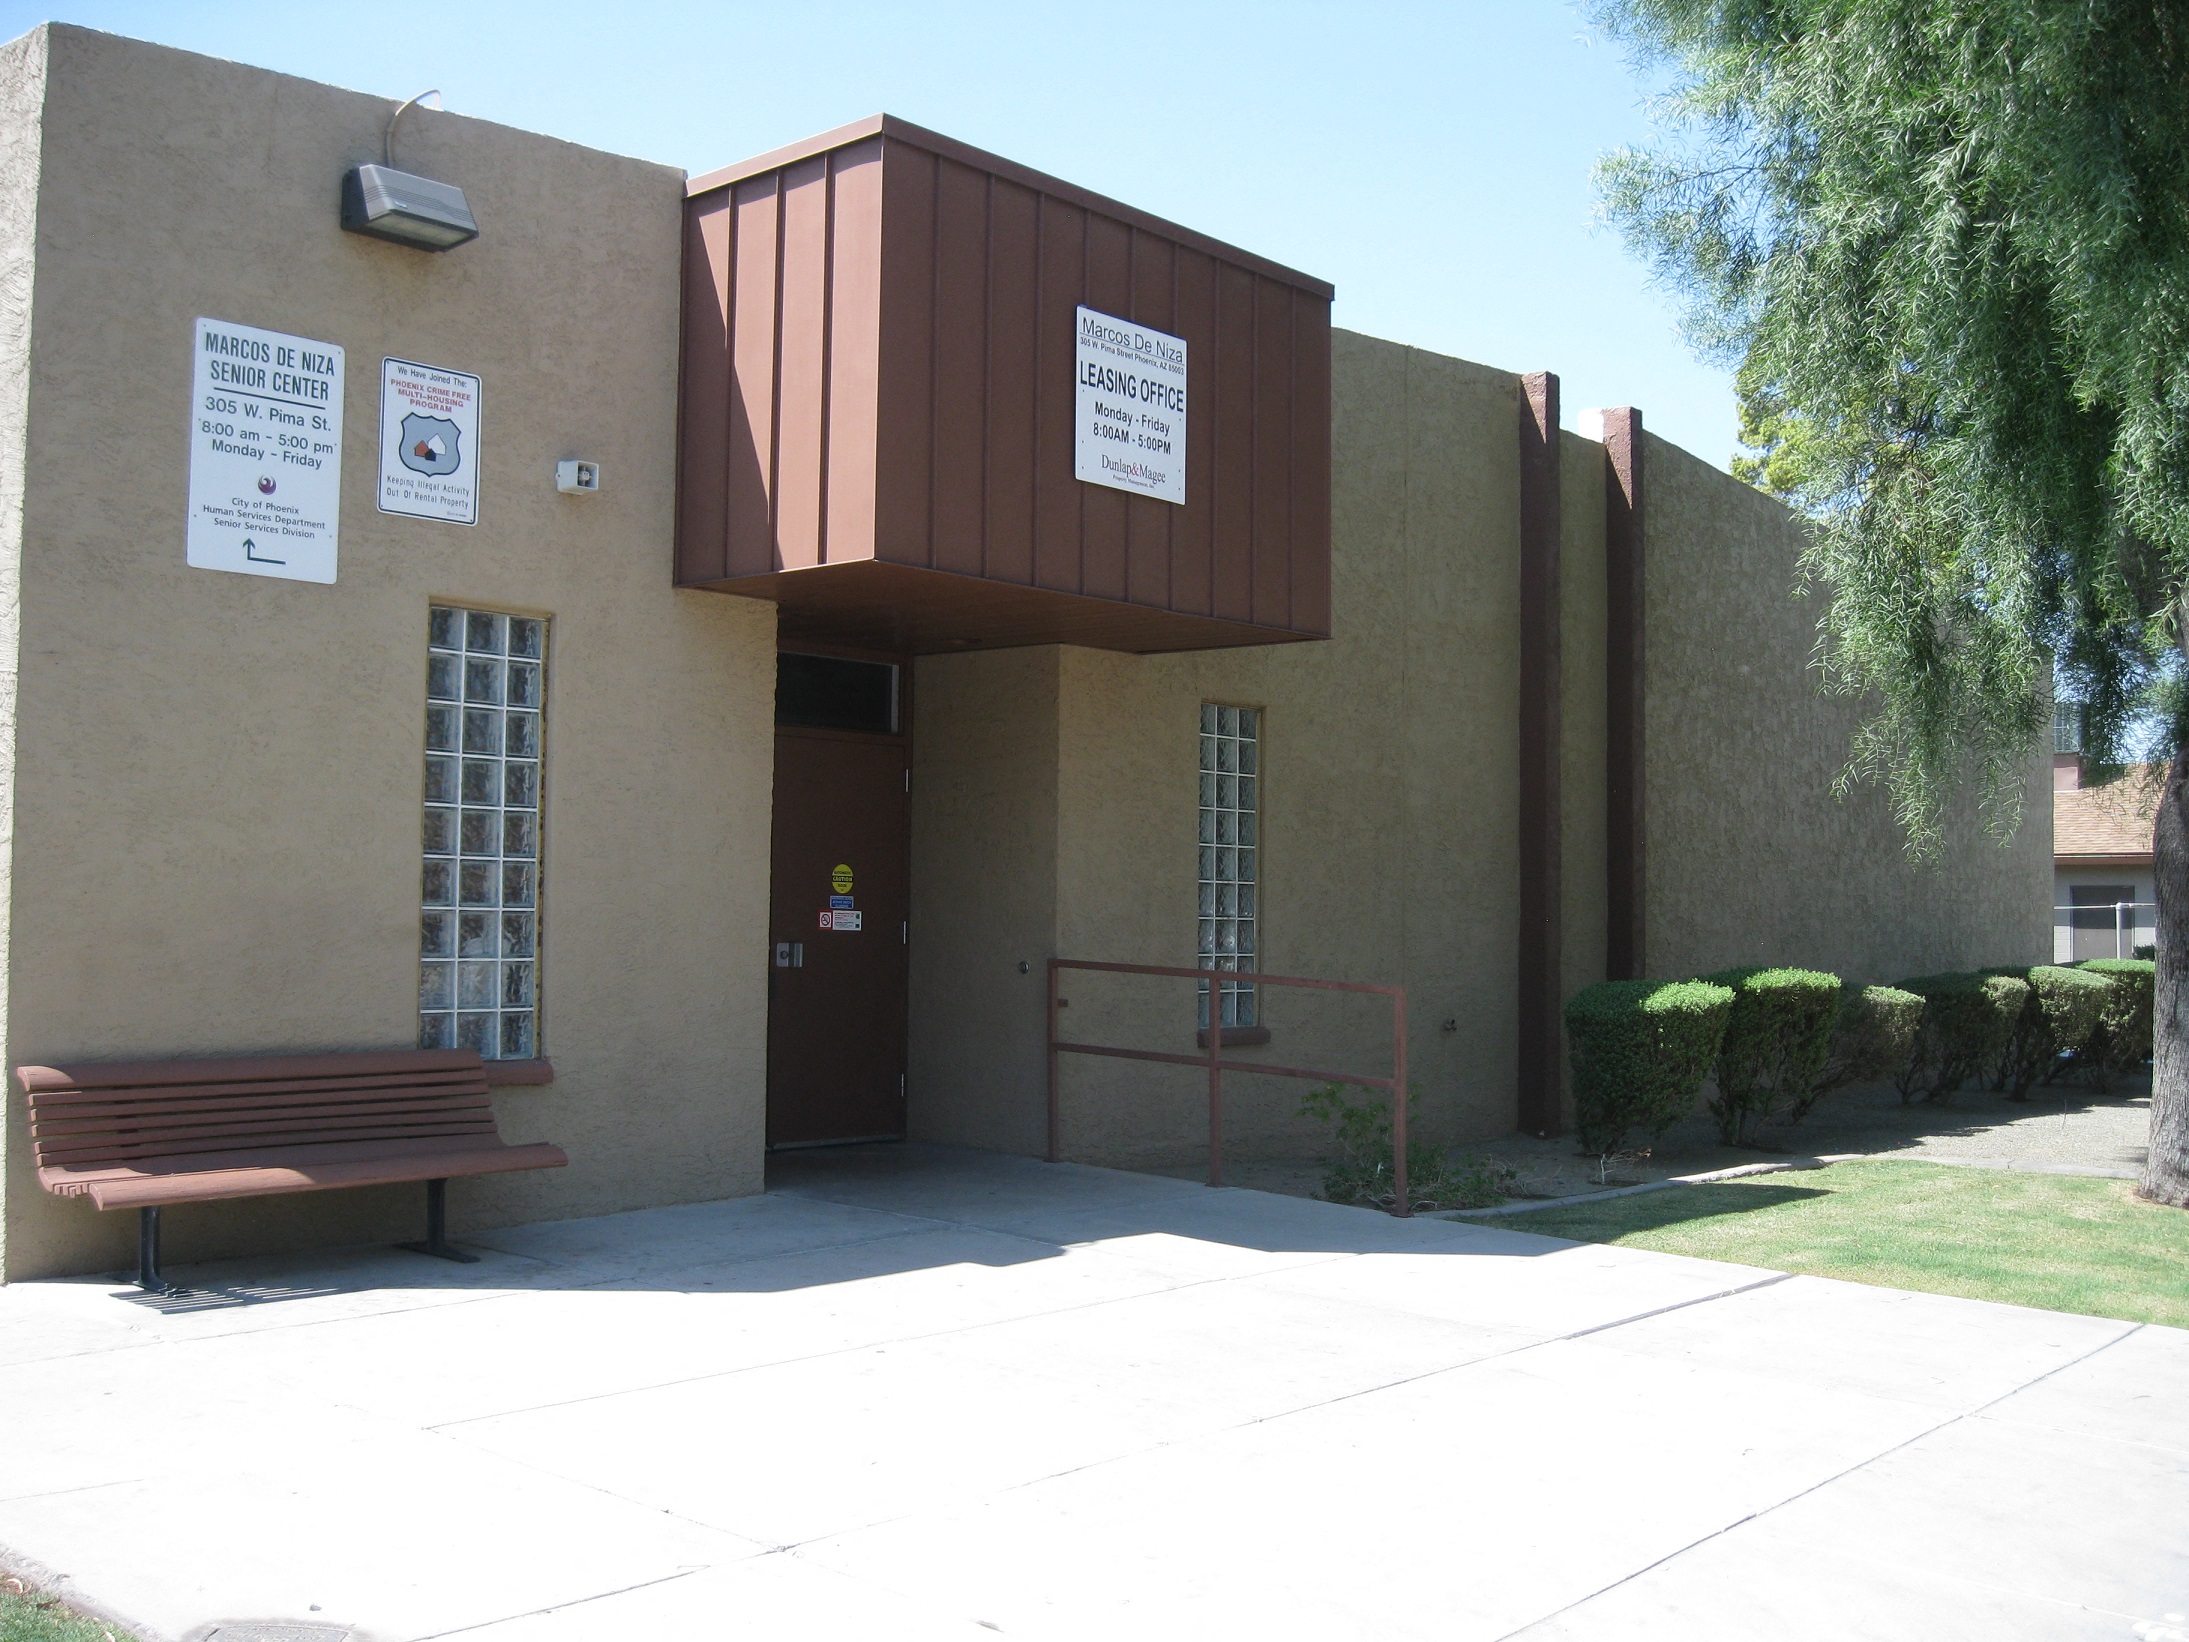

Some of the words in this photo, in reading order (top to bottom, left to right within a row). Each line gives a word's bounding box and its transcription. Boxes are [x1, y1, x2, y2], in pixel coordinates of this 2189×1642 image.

[205, 332, 270, 363] MARCOS
[277, 346, 295, 368] DE
[302, 351, 335, 376] NIZA
[1080, 336, 1091, 347] 305
[1091, 340, 1100, 349] W.
[1100, 342, 1115, 354] Pima
[1116, 348, 1134, 360] Street
[1134, 353, 1158, 369] Phoenix,
[1159, 361, 1167, 371] AZ
[1082, 316, 1130, 346] Marcos
[1134, 333, 1152, 353] De
[1156, 340, 1183, 363] Niza
[210, 360, 266, 389] SENIOR
[273, 371, 329, 401] CENTER
[390, 379, 424, 391] PHOENIX
[427, 386, 450, 397] CRIME
[452, 391, 471, 400] FREE
[398, 366, 408, 375] We
[410, 368, 426, 379] Have
[429, 373, 450, 384] Joined
[454, 377, 467, 387] The:
[1080, 360, 1137, 399] LEASING
[1140, 378, 1184, 413] OFFICE
[398, 388, 464, 407] MULTI-HOUSING
[410, 399, 452, 413] PROGRAM
[205, 396, 237, 414] 305
[244, 402, 262, 419] W.
[269, 407, 305, 426] Pima
[311, 415, 331, 431] St.
[1095, 401, 1133, 427] Monday
[1141, 413, 1170, 437] Friday
[201, 420, 234, 437] 8:00
[240, 429, 260, 441] am
[278, 434, 309, 449] 5:00
[313, 442, 333, 454] pm
[1093, 422, 1129, 444] 8:00AM
[1138, 433, 1171, 455] 5:00PM
[212, 439, 265, 460] Monday
[283, 450, 322, 470] Friday
[386, 487, 399, 497] Out
[403, 489, 411, 499] Of
[414, 491, 437, 503] Rental
[440, 496, 469, 510] Property
[387, 475, 414, 488] Keeping
[418, 480, 439, 492] Illegal
[443, 484, 470, 498] Activity
[203, 504, 234, 516] Human
[237, 509, 271, 522] Services
[275, 515, 325, 529] Department
[231, 497, 249, 508] City
[253, 500, 262, 509] of
[265, 502, 300, 514] Phoenix
[214, 517, 241, 528] Senior
[245, 521, 279, 534] Services
[282, 527, 315, 539] Division
